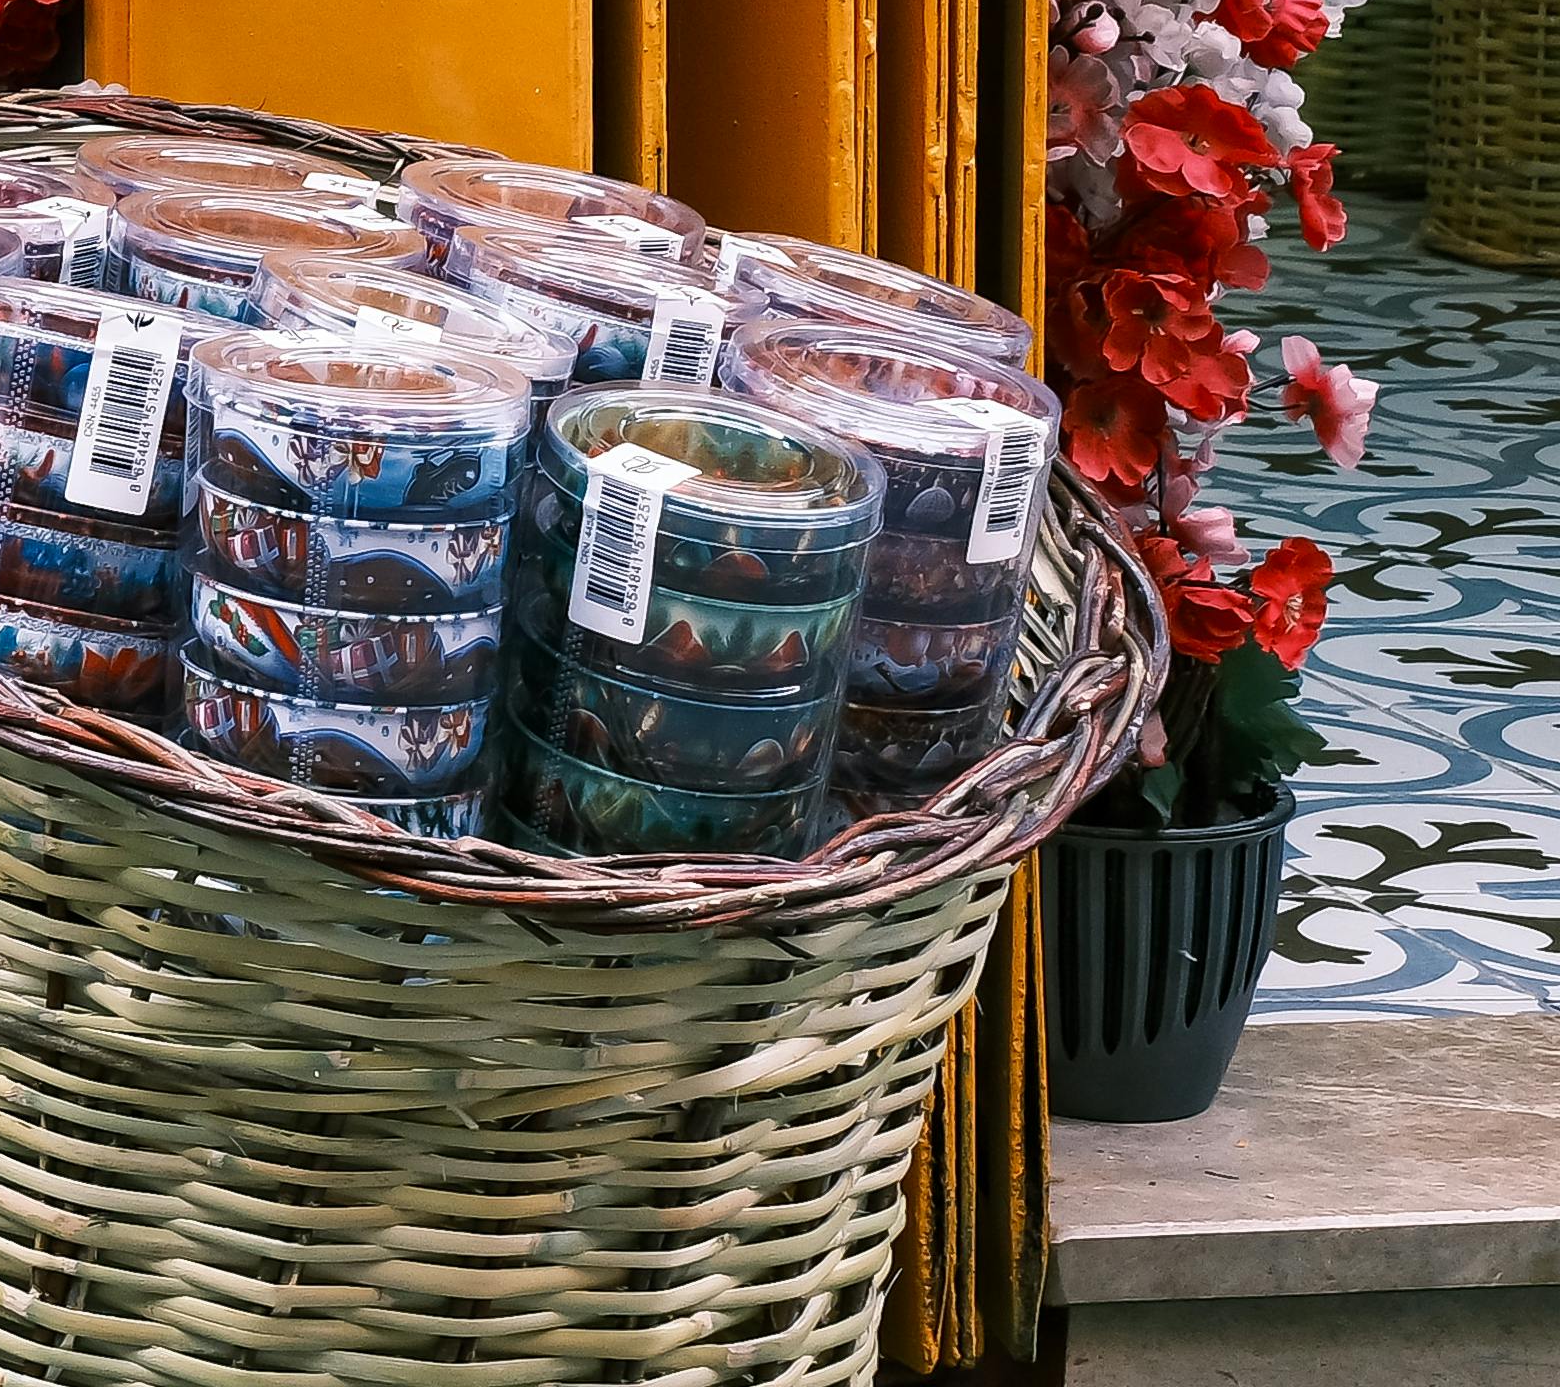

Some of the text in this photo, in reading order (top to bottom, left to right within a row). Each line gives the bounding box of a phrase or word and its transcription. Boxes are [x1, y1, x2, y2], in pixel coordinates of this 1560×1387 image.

[133, 423, 155, 478] 654841
[145, 360, 167, 415] 514251
[634, 495, 652, 550] 514251
[626, 556, 644, 611] 654841
